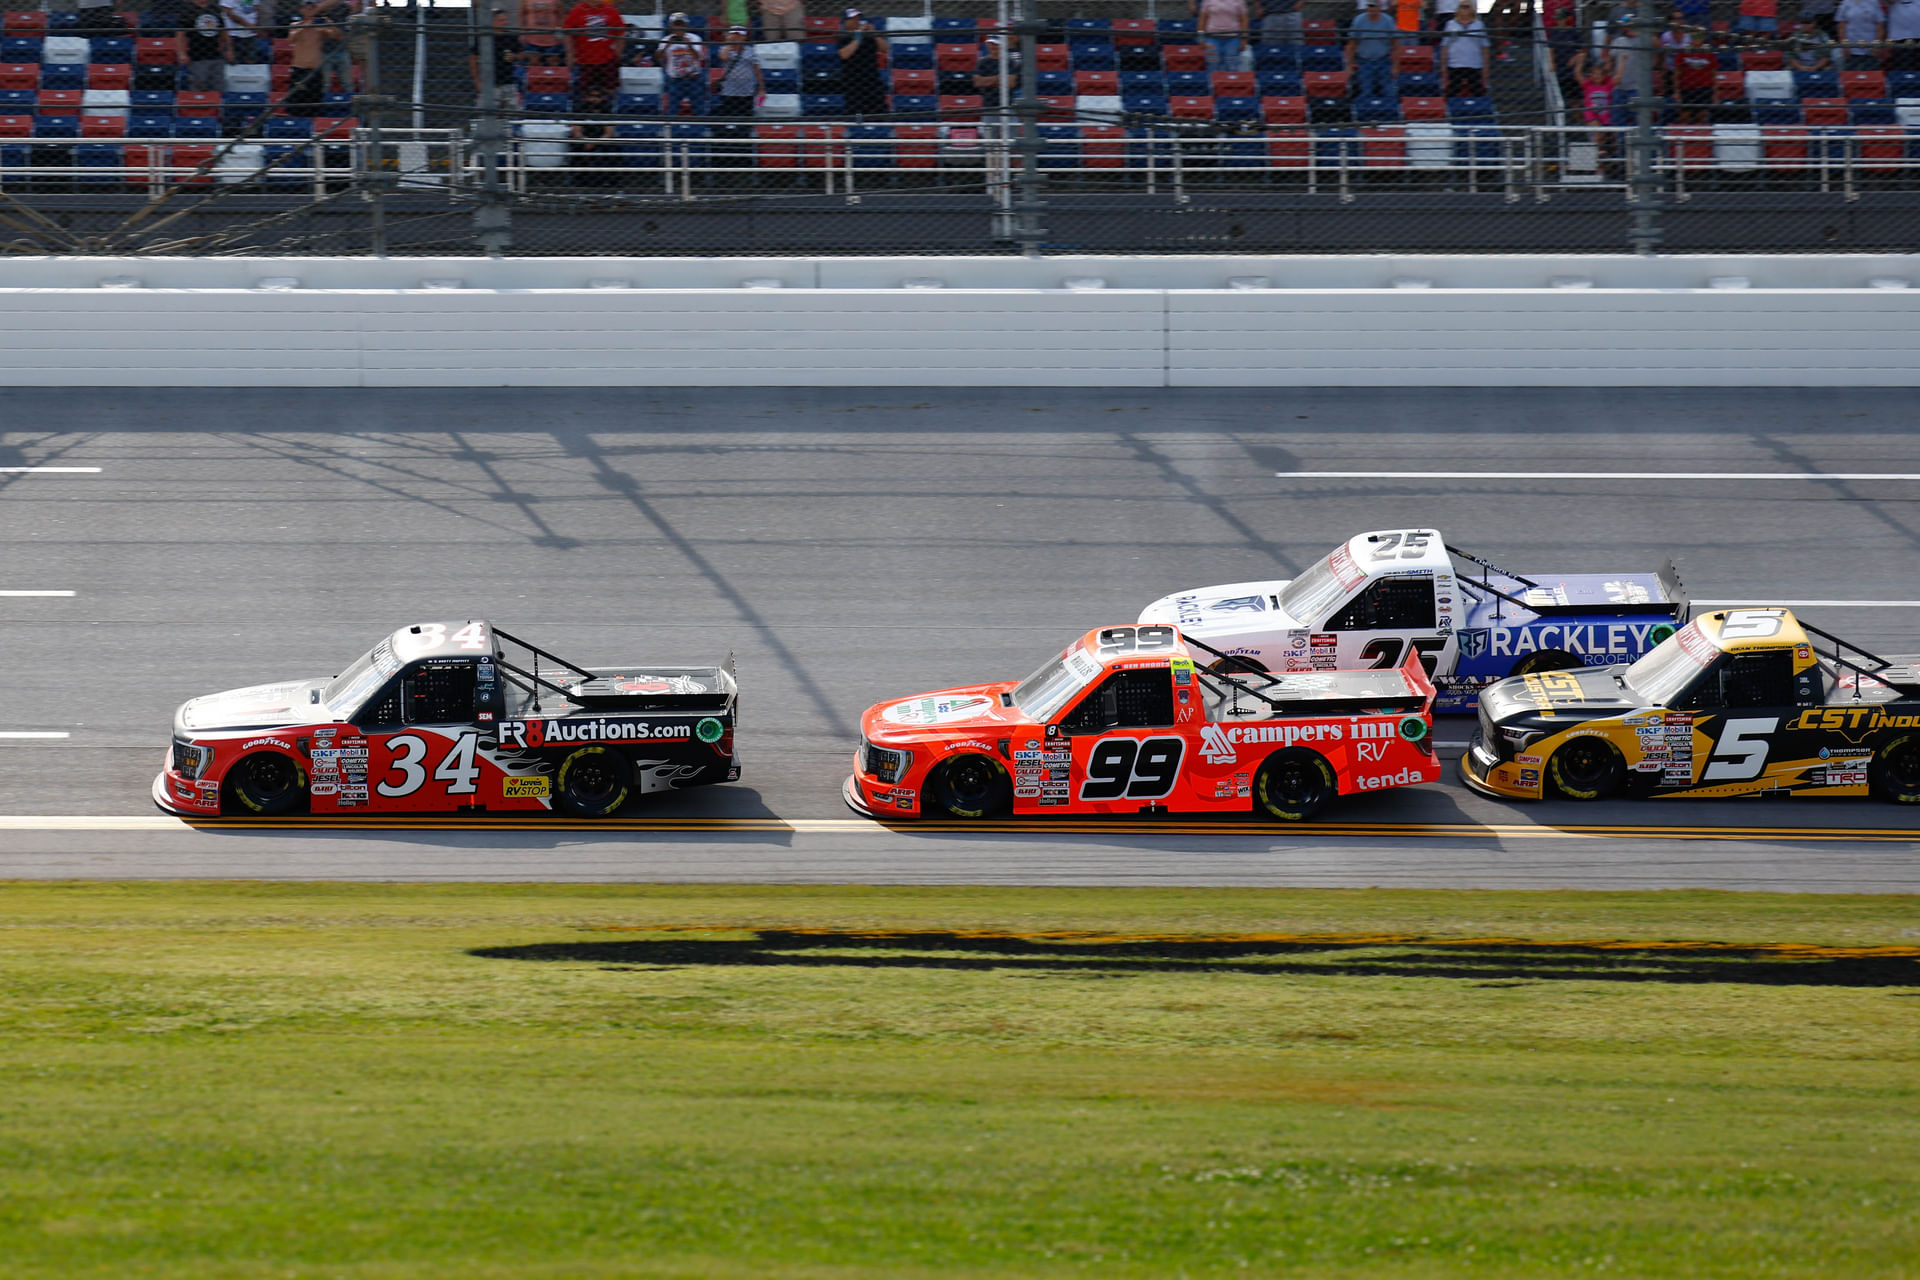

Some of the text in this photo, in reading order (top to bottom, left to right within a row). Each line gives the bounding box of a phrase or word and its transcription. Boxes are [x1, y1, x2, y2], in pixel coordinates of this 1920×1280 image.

[1371, 533, 1430, 561] 25
[1474, 557, 1518, 580] CHEVROLET
[414, 621, 487, 651] 34
[1720, 610, 1787, 640] 5
[1099, 626, 1177, 655] 99
[1491, 624, 1651, 657] RACKLEY
[1213, 647, 1261, 658] GODYEAR
[1584, 654, 1646, 665] ROOFIN
[1798, 708, 1869, 729] CST
[498, 718, 691, 748] FR8Auctions.com
[1048, 725, 1057, 736] 8
[1227, 724, 1344, 747] campers
[1350, 717, 1396, 740] inn
[242, 737, 292, 750] GOODYEAR
[312, 749, 338, 758] SKF
[944, 739, 993, 751] GOODYEAR
[1357, 740, 1391, 762] RV
[1703, 716, 1780, 781] 5
[376, 731, 481, 798] 34
[1079, 735, 1187, 801] 99
[1357, 767, 1422, 790] tenda
[1828, 772, 1867, 784] TRD
[889, 788, 915, 796] ARP
